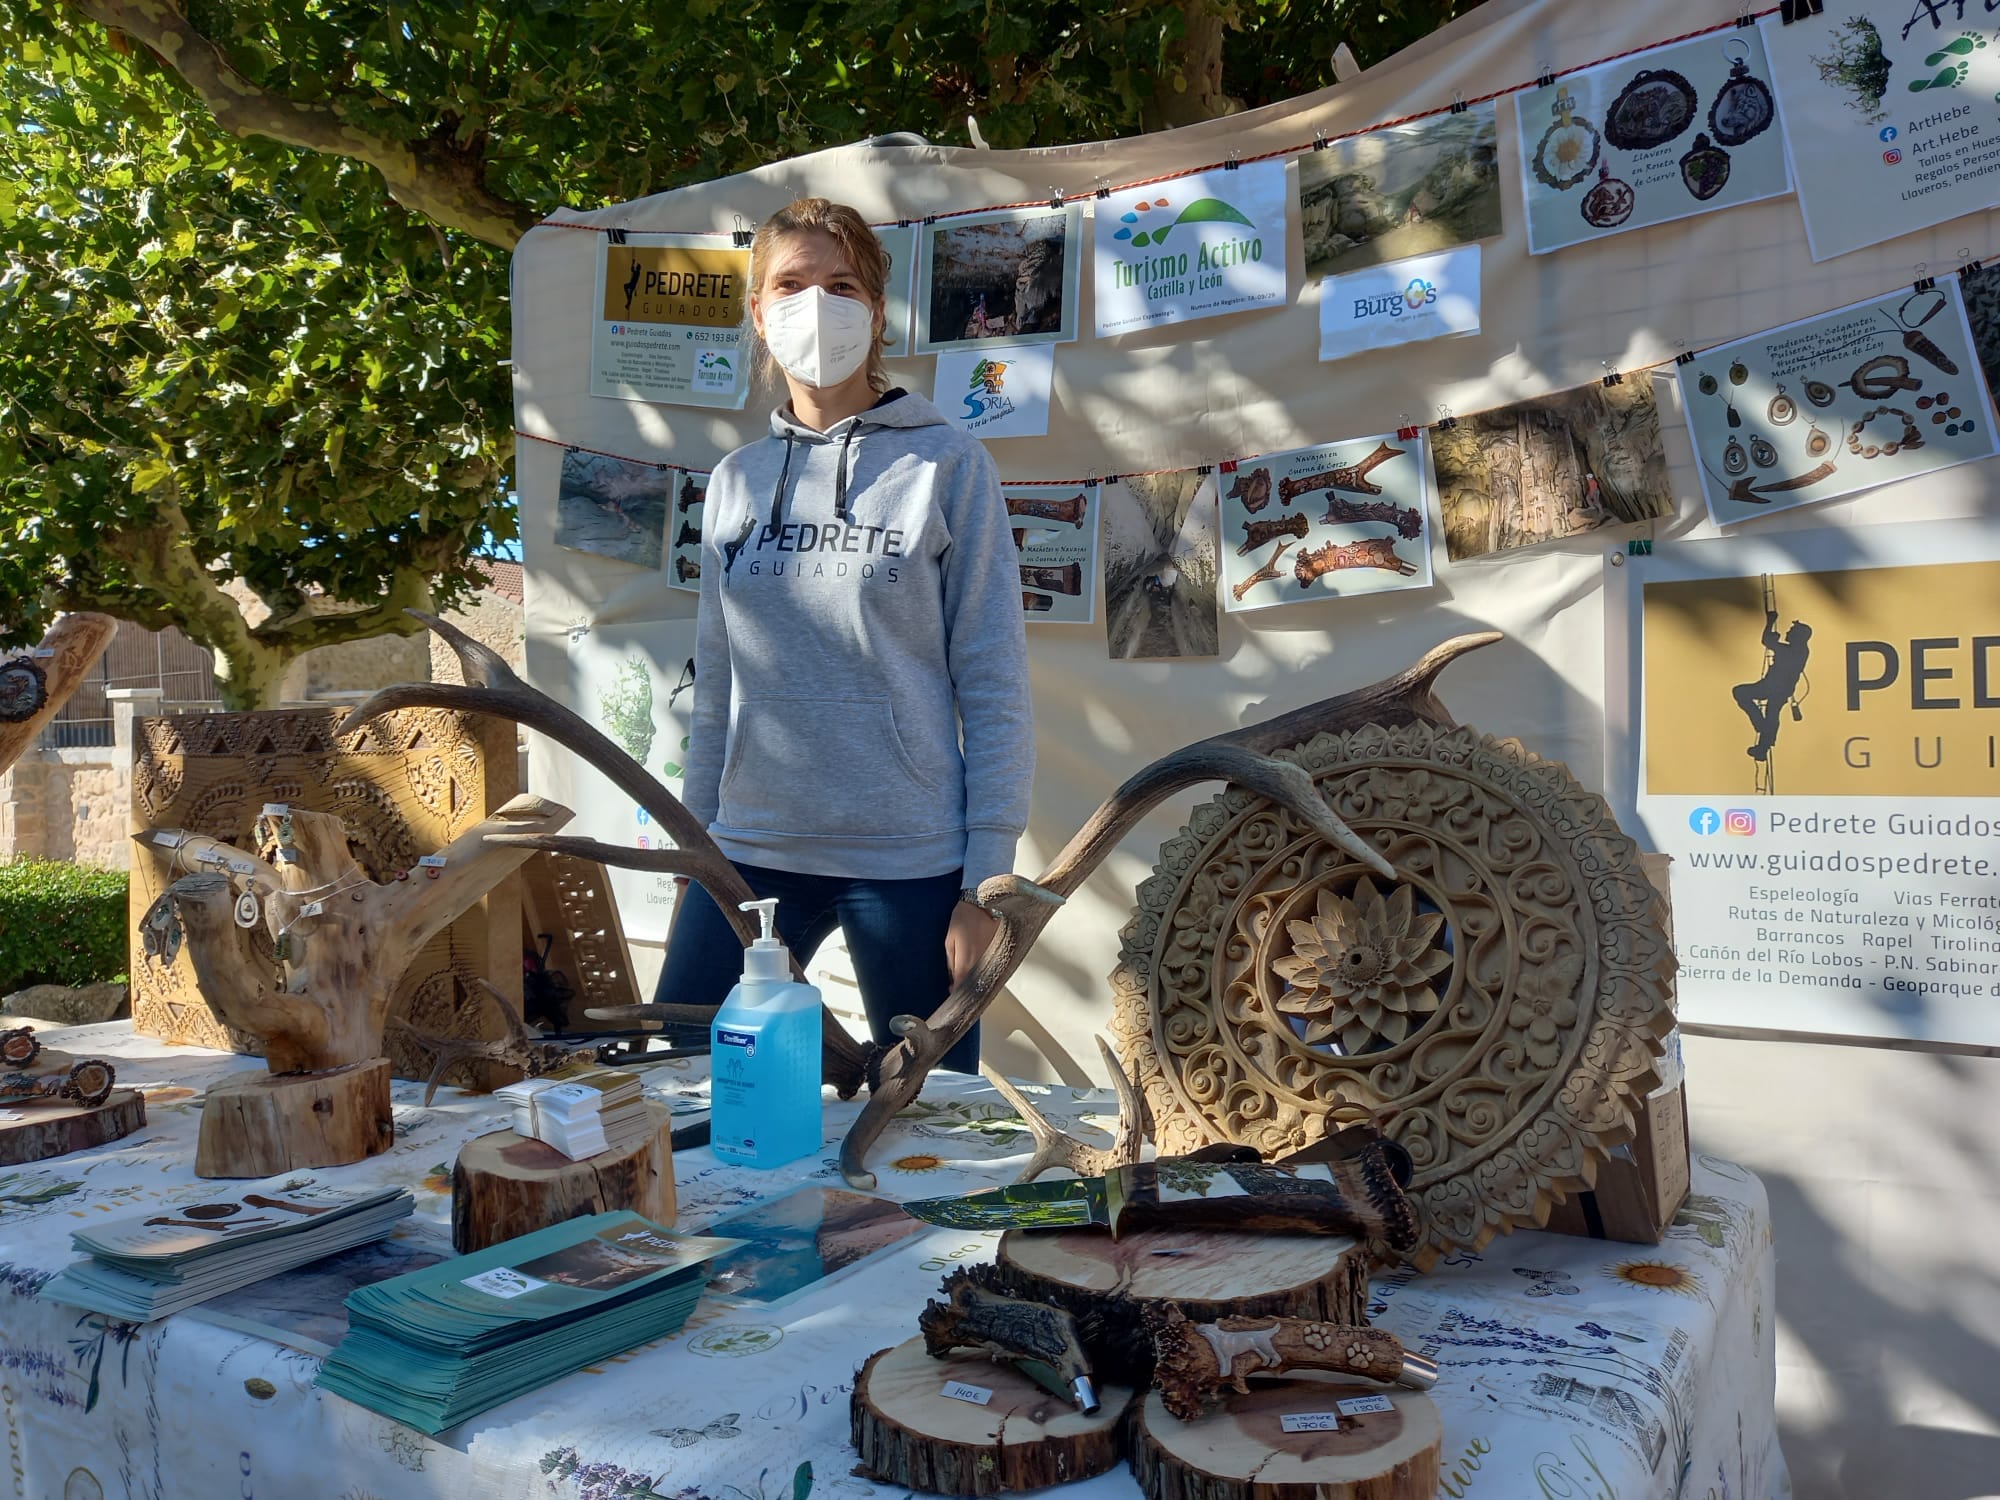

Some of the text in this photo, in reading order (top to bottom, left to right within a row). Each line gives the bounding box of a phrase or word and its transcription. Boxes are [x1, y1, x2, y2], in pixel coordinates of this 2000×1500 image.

[1908, 105, 1971, 134] ArtHebe
[1912, 125, 1979, 155] Art.Hebe
[1918, 152, 1952, 168] Tallas
[1955, 146, 1969, 156] en
[1914, 162, 1960, 183] Regalos
[1901, 180, 1952, 201] Llaveros,
[1113, 237, 1263, 290] Turismo Activo
[645, 271, 733, 299] PEDRETE
[1147, 273, 1223, 301] Castilla y León
[1353, 278, 1437, 319] Burgos
[643, 302, 729, 319] GUIADOS
[627, 327, 648, 336] Pedrete
[649, 328, 672, 338] Guiados
[694, 331, 709, 341] 652
[712, 332, 724, 342] 193
[960, 387, 1013, 420] SORIA
[756, 523, 904, 558] PEDRETE
[749, 560, 899, 583] GUIADOS
[1844, 736, 1995, 769] GUI
[1770, 812, 1876, 835] Pedrete
[1689, 850, 1997, 879] www.guiadospedrete.
[1749, 886, 1859, 906] Espeleología
[1893, 890, 1933, 906] Vias
[1728, 905, 1778, 921] Rutas
[1784, 908, 1804, 922] de
[1810, 909, 1909, 926] Naturaleza
[1916, 917, 1925, 931] y
[1757, 927, 1845, 945] Barrancos
[1863, 932, 1912, 951] Rapel
[1690, 945, 1740, 960] Cañón
[1747, 947, 1771, 962] del
[1778, 949, 1805, 964] Río
[1812, 951, 1863, 967] Lobos
[1884, 955, 1919, 970] P.N.
[1926, 957, 1999, 975] Sabinar
[1679, 964, 1726, 980] Sierra
[1732, 968, 1751, 982] de
[1757, 969, 1772, 983] la
[1779, 970, 1862, 988] Demanda
[1883, 976, 1983, 998] Geoparque
